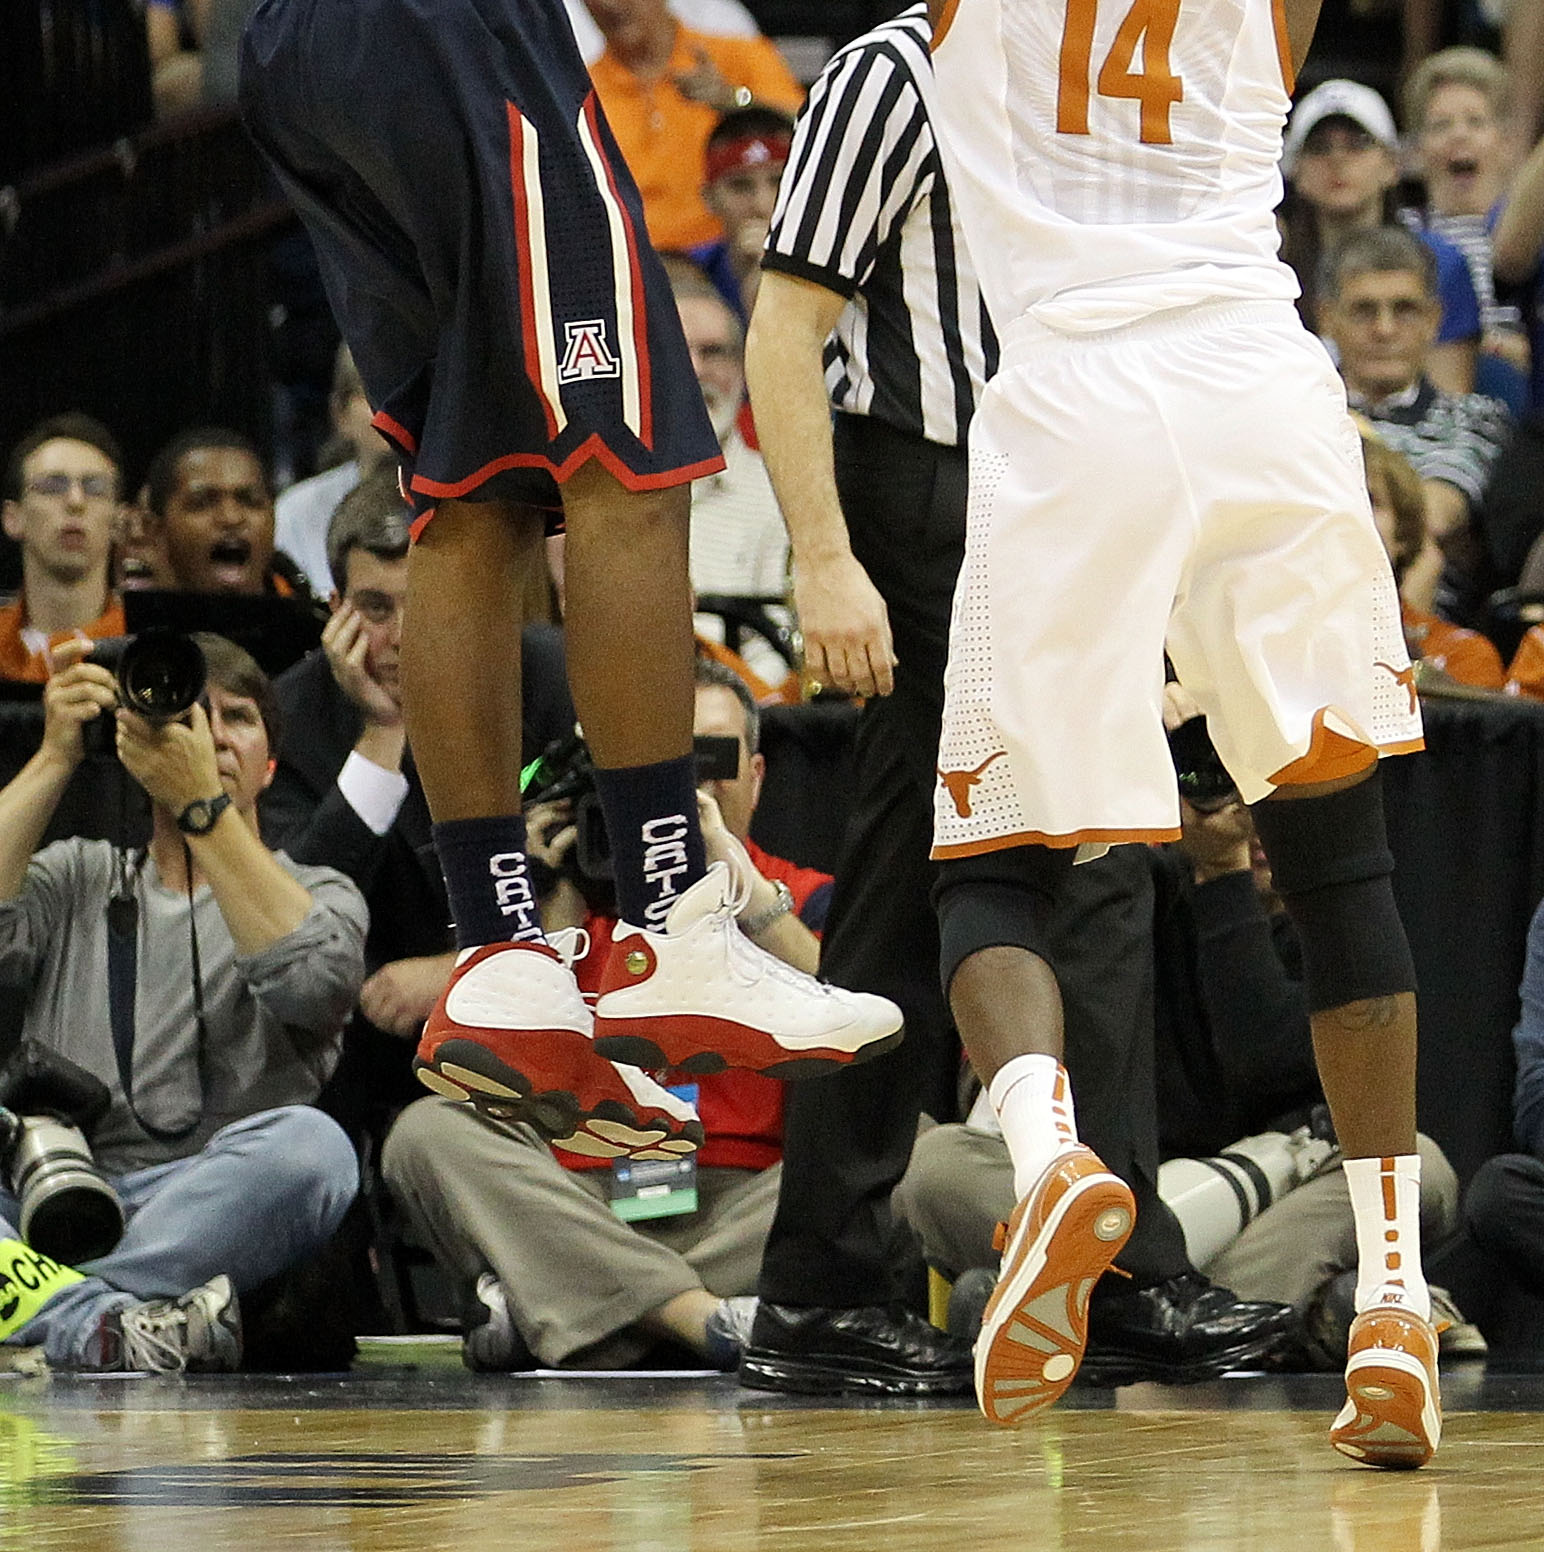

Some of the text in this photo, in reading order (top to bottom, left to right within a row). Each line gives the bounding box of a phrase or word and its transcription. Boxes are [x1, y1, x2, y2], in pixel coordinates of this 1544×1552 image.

[558, 319, 620, 385] A
[12, 1251, 62, 1290] CH
[1381, 1293, 1404, 1303] NIKE
